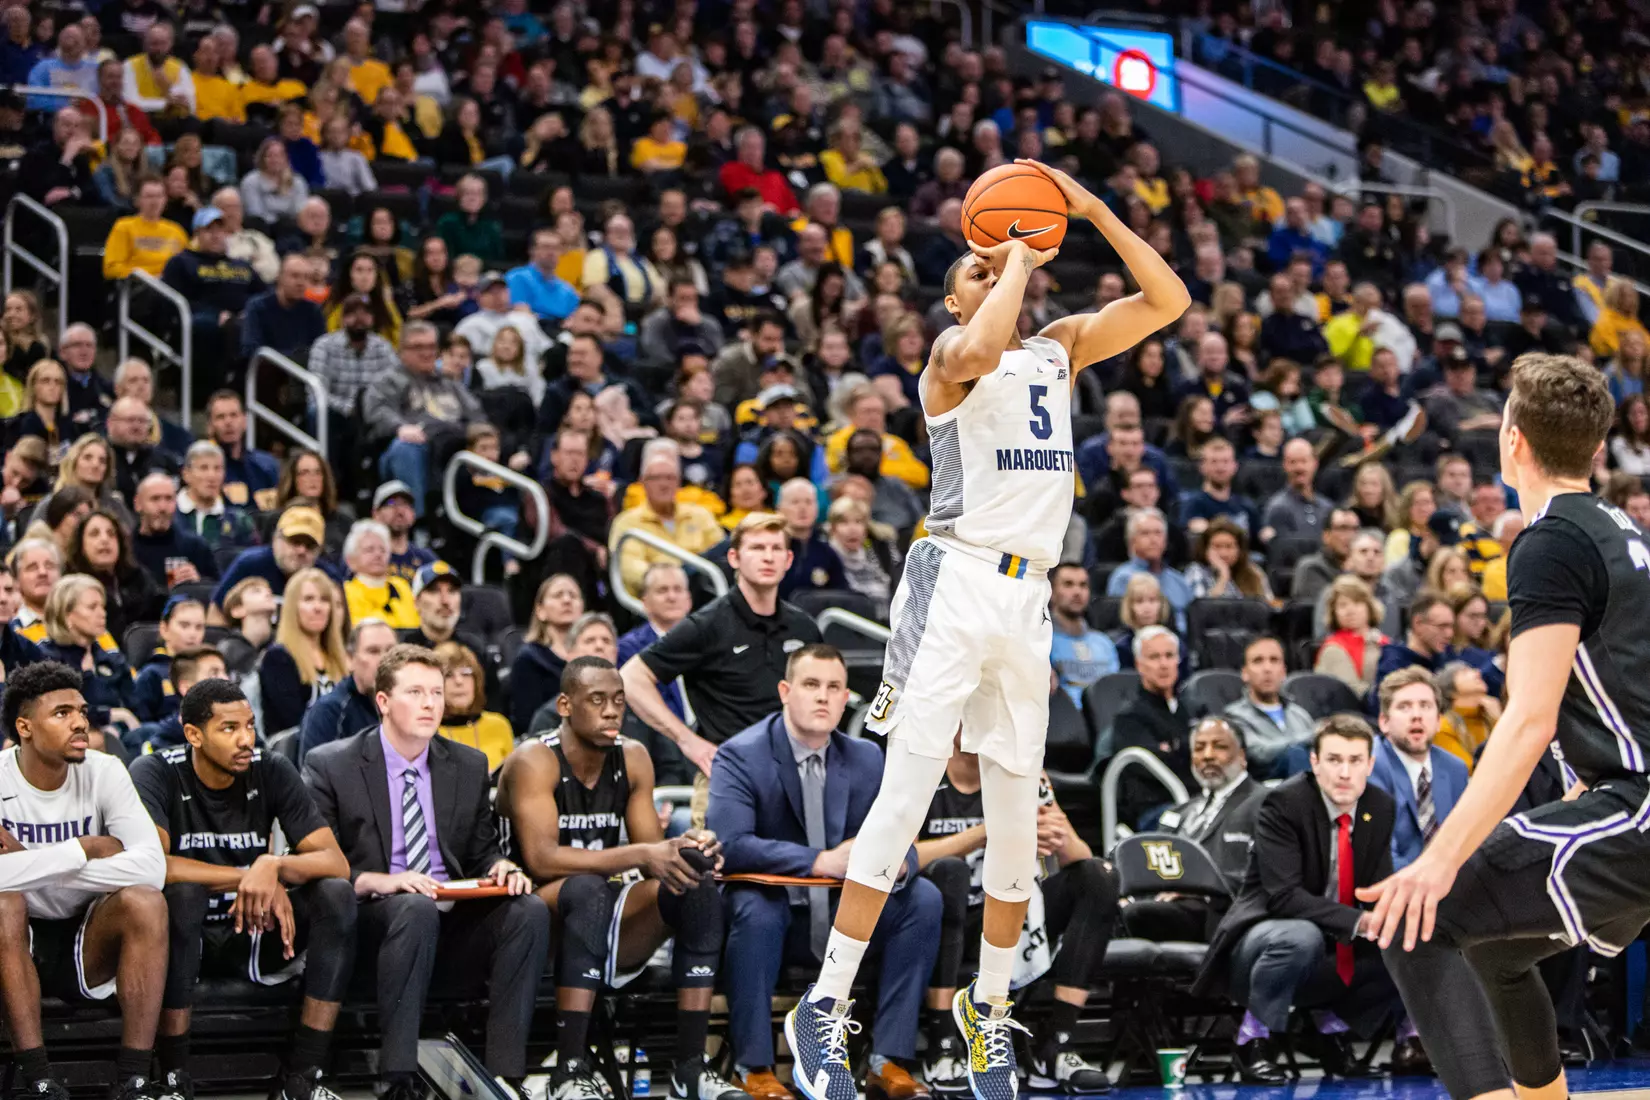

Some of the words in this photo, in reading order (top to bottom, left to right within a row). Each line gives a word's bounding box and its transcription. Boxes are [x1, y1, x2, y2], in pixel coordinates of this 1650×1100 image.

[1028, 384, 1053, 440] 5
[928, 817, 985, 833] CENT
[1142, 842, 1184, 879] MU
